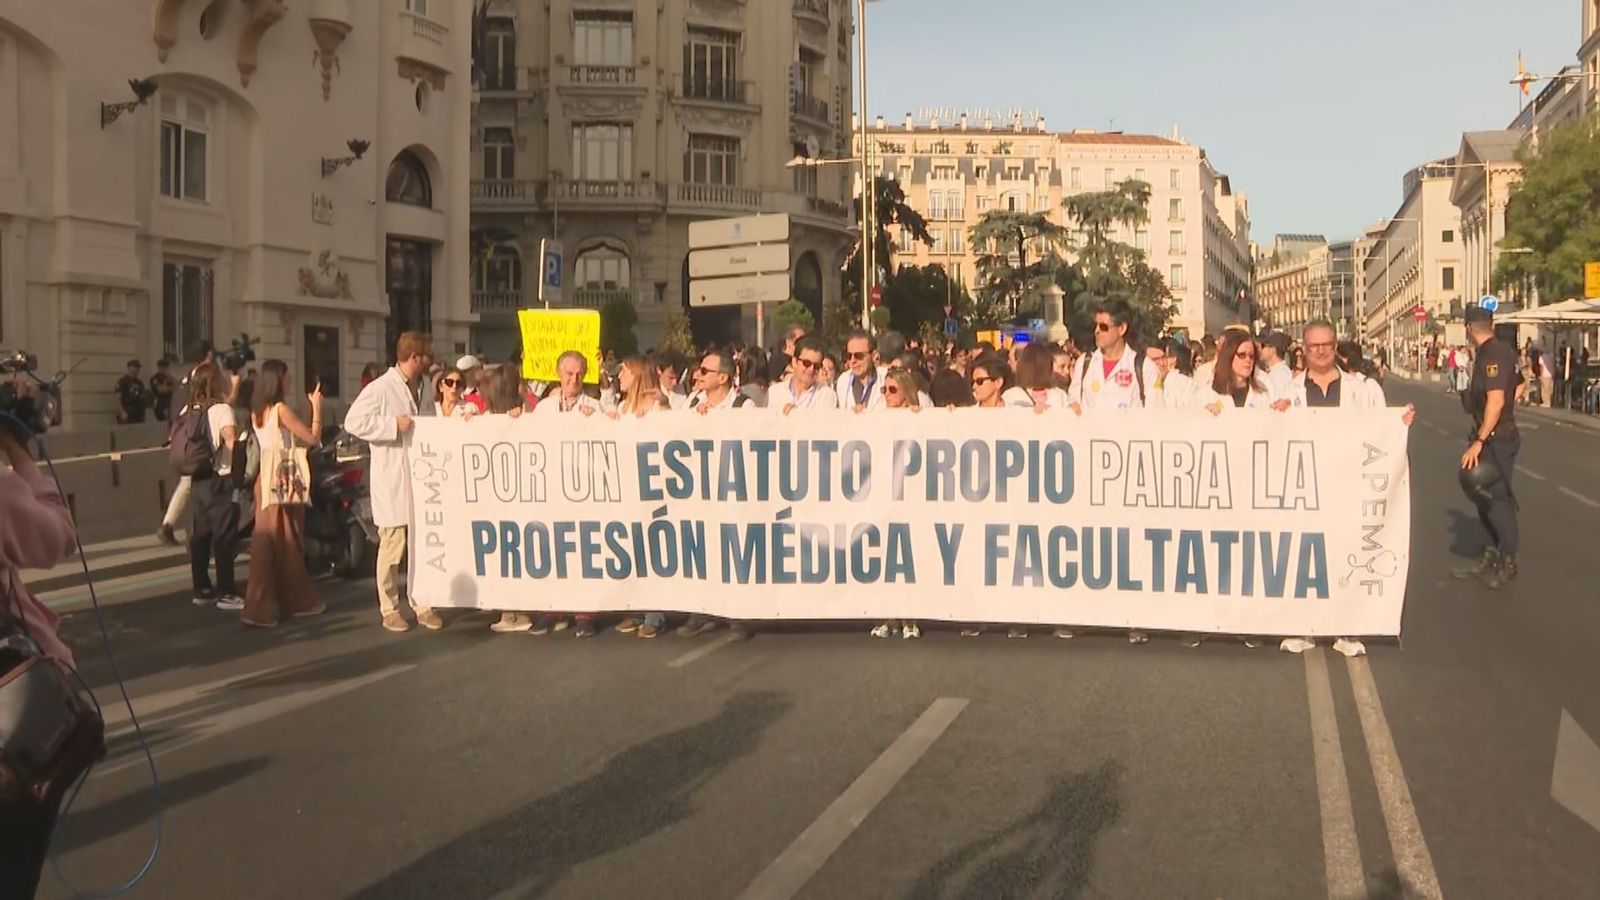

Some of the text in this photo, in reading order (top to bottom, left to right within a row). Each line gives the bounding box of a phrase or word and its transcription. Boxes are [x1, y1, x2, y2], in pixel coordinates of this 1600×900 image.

[462, 439, 1320, 511] POR UN ESTATUTO PROPIO PARA LA
[471, 504, 1330, 600] PROFESIÓN MÉDICA Y FACULTATIVA
